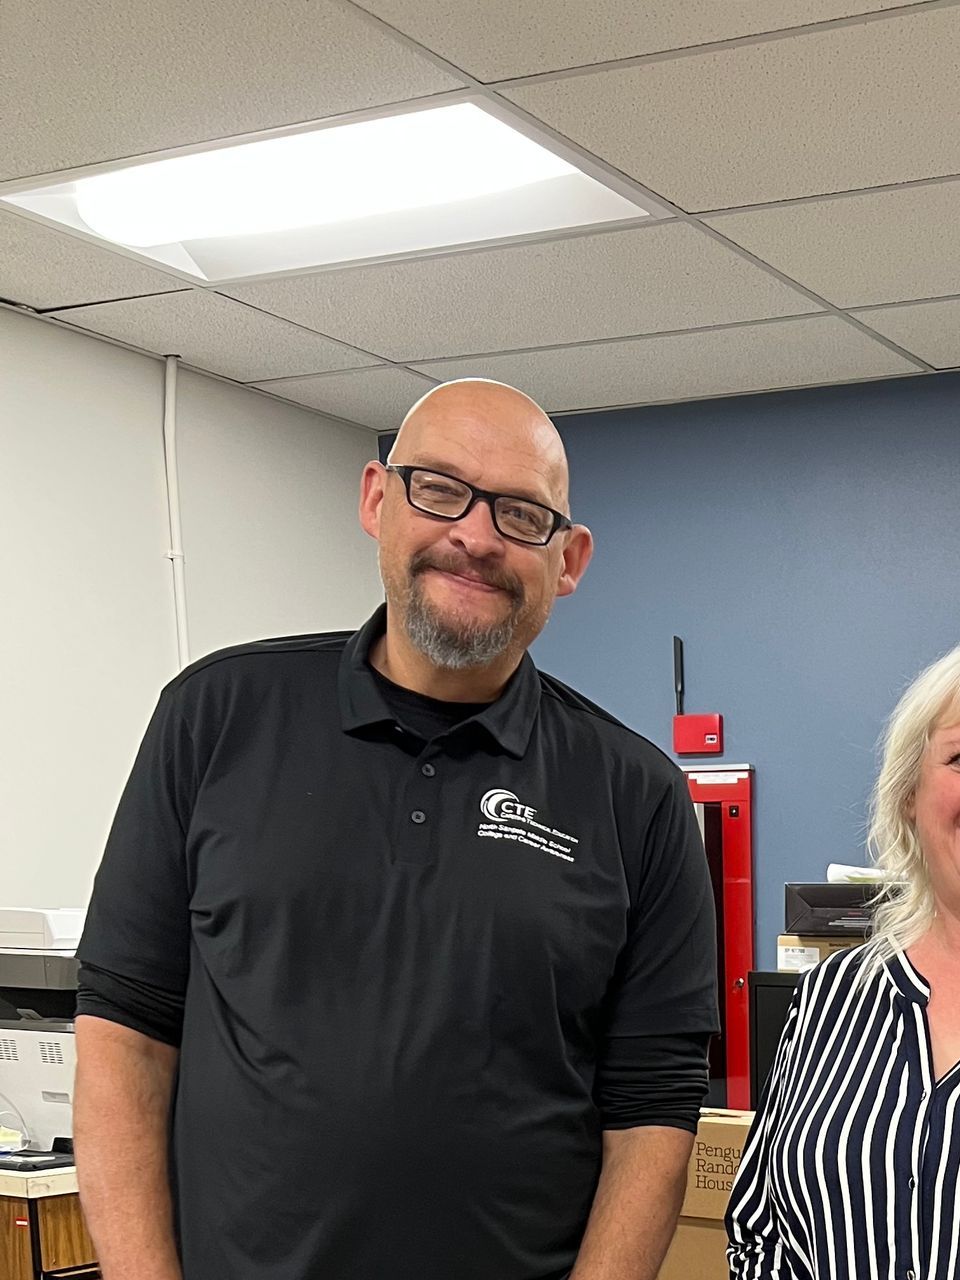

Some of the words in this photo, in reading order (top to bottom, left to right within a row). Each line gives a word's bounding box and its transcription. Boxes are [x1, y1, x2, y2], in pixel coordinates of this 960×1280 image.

[501, 801, 537, 819] CTE
[696, 1142, 742, 1162] Pengu
[696, 1158, 740, 1176] Rando
[696, 1174, 733, 1192] Hous
